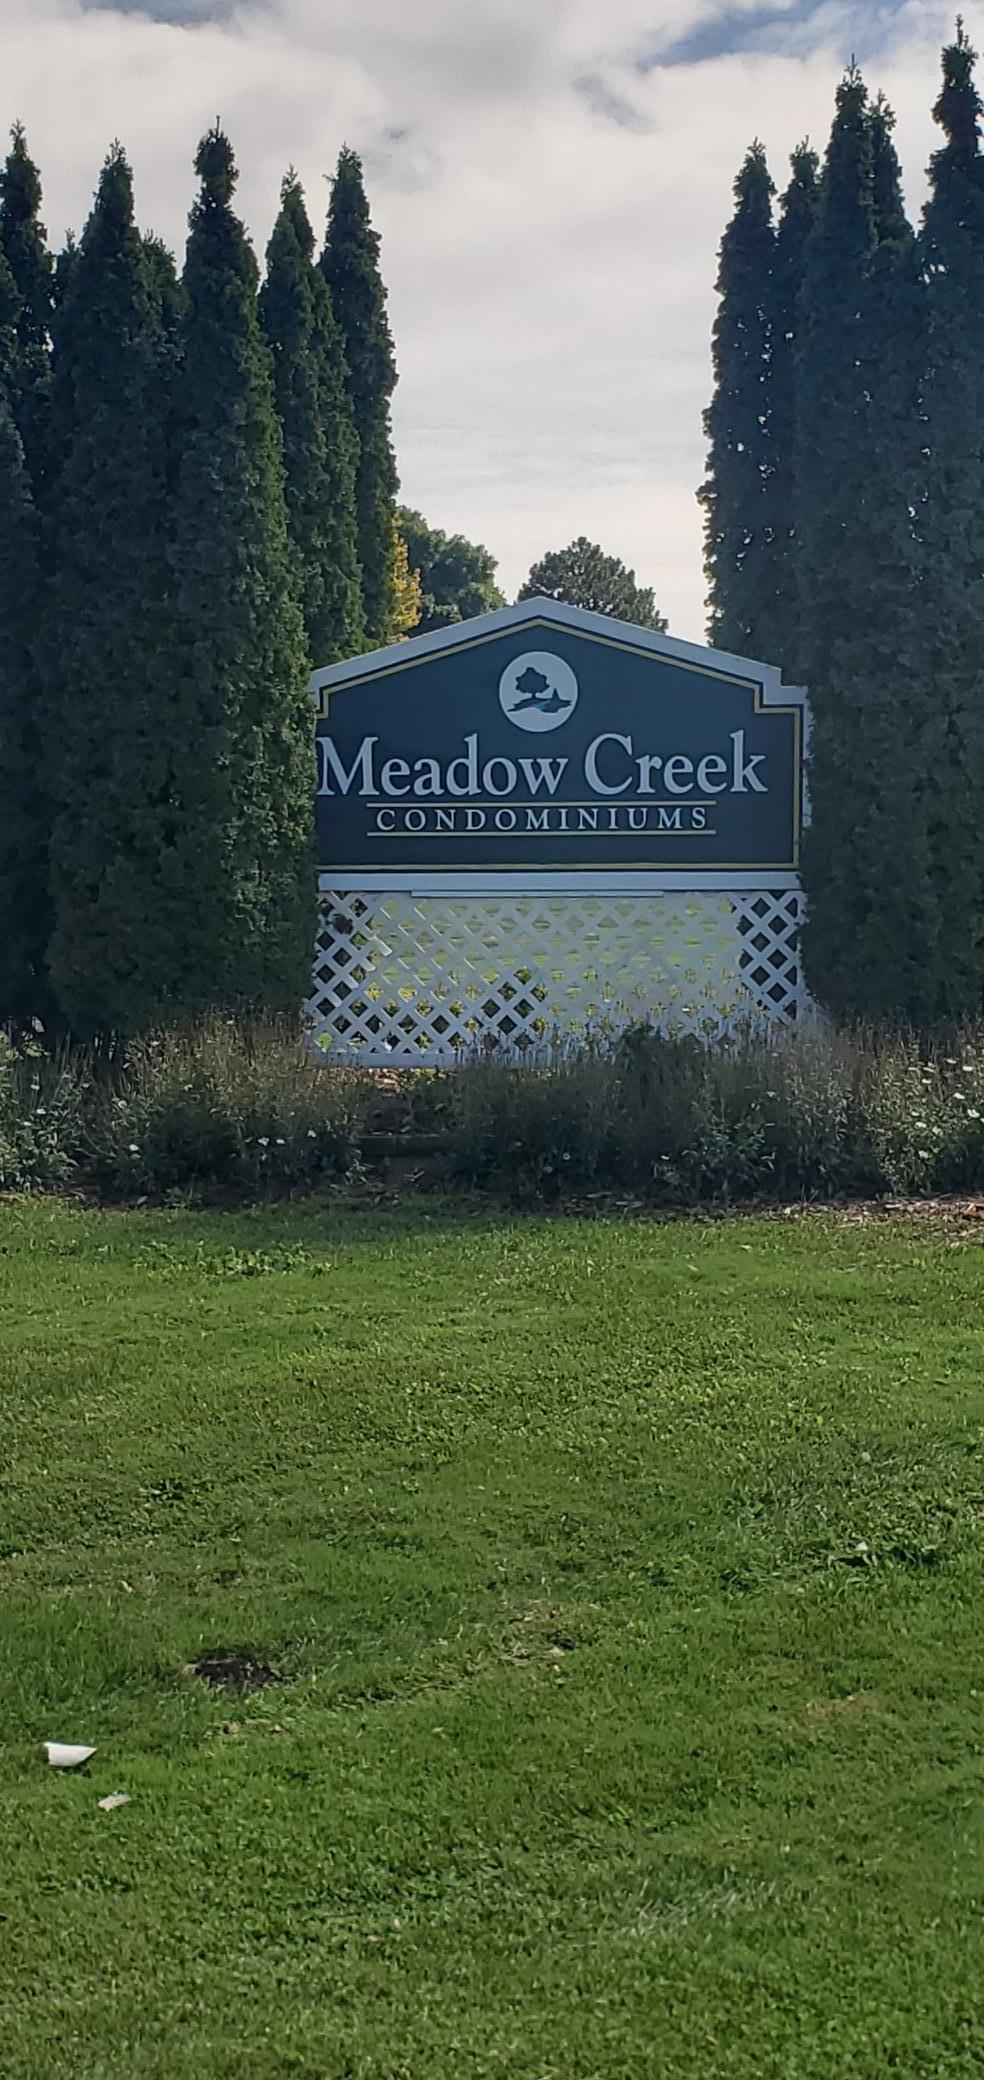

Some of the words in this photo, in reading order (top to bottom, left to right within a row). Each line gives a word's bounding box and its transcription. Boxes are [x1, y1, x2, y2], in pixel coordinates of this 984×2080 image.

[316, 733, 568, 796] Meadow
[584, 730, 768, 794] Creek
[376, 808, 706, 831] CONDOMINIUMS
